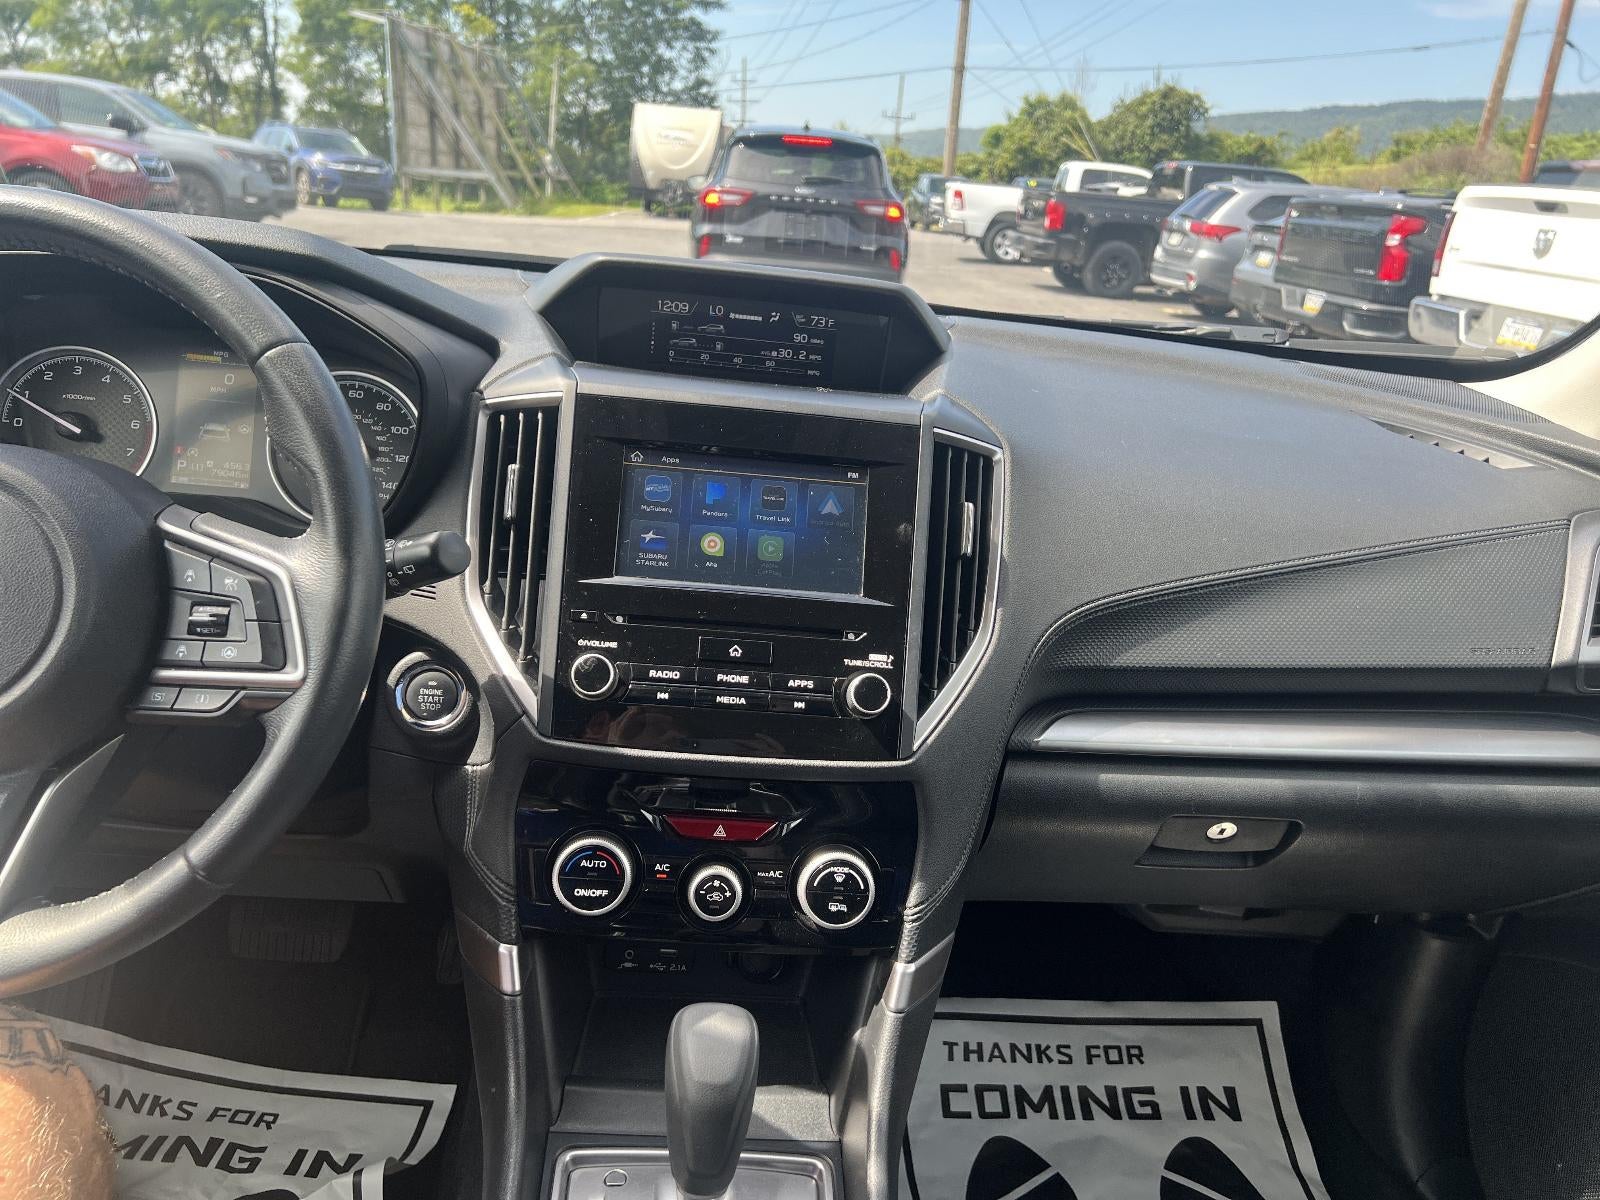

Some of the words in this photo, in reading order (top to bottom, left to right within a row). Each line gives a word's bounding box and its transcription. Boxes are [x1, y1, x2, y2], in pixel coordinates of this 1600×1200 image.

[658, 300, 689, 313] 12:09
[709, 305, 724, 316] LO
[793, 333, 808, 343] 90
[778, 348, 807, 360] 30.2
[73, 366, 83, 375] 3
[44, 371, 54, 381] 2
[101, 375, 111, 384] 4
[224, 373, 235, 385] 0
[210, 385, 227, 394] MPH
[24, 390, 30, 399] 1
[122, 394, 132, 404] 5
[348, 390, 364, 399] 60
[376, 402, 392, 411] 80
[13, 417, 23, 427] 0
[130, 420, 140, 430] 6
[390, 426, 409, 435] 100
[126, 448, 135, 457] 7
[661, 456, 680, 464] Apps
[177, 460, 187, 471] P
[702, 509, 728, 518] Pandora
[756, 514, 776, 522] Travel
[638, 552, 668, 560] SUBARU
[635, 559, 670, 567] STARLINK
[843, 658, 893, 669] TUNE/SCROLL
[649, 669, 680, 679] RADIO
[716, 673, 750, 684] PHONE
[787, 679, 814, 689] APPS
[419, 687, 444, 696] ENGINE
[417, 695, 444, 703] START
[716, 695, 747, 705] MEDIA
[420, 702, 441, 711] STOP
[580, 859, 607, 868] AUTO
[654, 863, 671, 871] A/C
[768, 870, 783, 878] A/C
[574, 888, 609, 897] ON/OFF
[942, 1040, 1073, 1065] THANKS
[1085, 1044, 1145, 1065] FOR
[96, 1083, 199, 1122] ANKS
[205, 1106, 280, 1131] FOR
[939, 1083, 1163, 1121] COMING
[1180, 1085, 1243, 1122] IN
[114, 1134, 268, 1174] MING
[283, 1148, 364, 1178] IN
